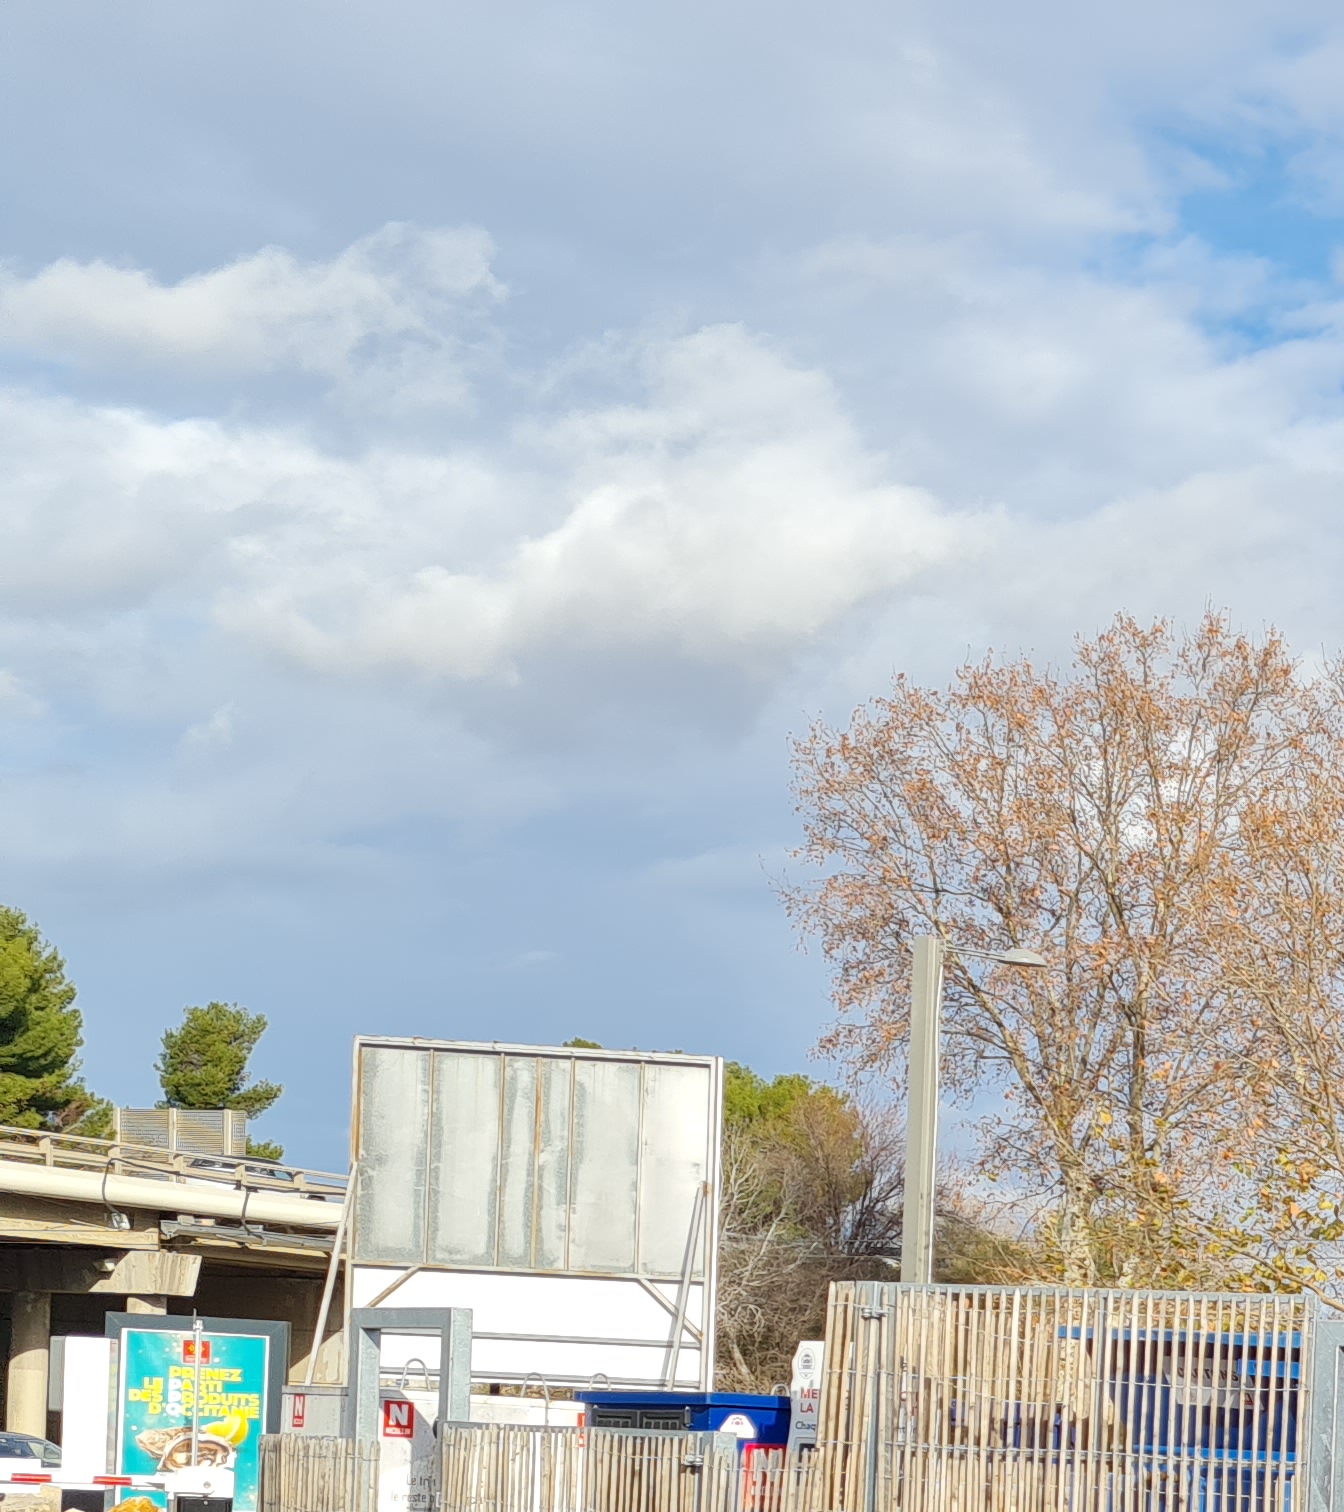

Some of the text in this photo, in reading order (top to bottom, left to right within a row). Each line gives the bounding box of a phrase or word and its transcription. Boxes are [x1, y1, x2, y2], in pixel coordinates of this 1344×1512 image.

[169, 1365, 242, 1382] PRENEZ
[143, 1377, 163, 1390] LE
[128, 1388, 163, 1403] DES
[389, 1404, 409, 1425] N
